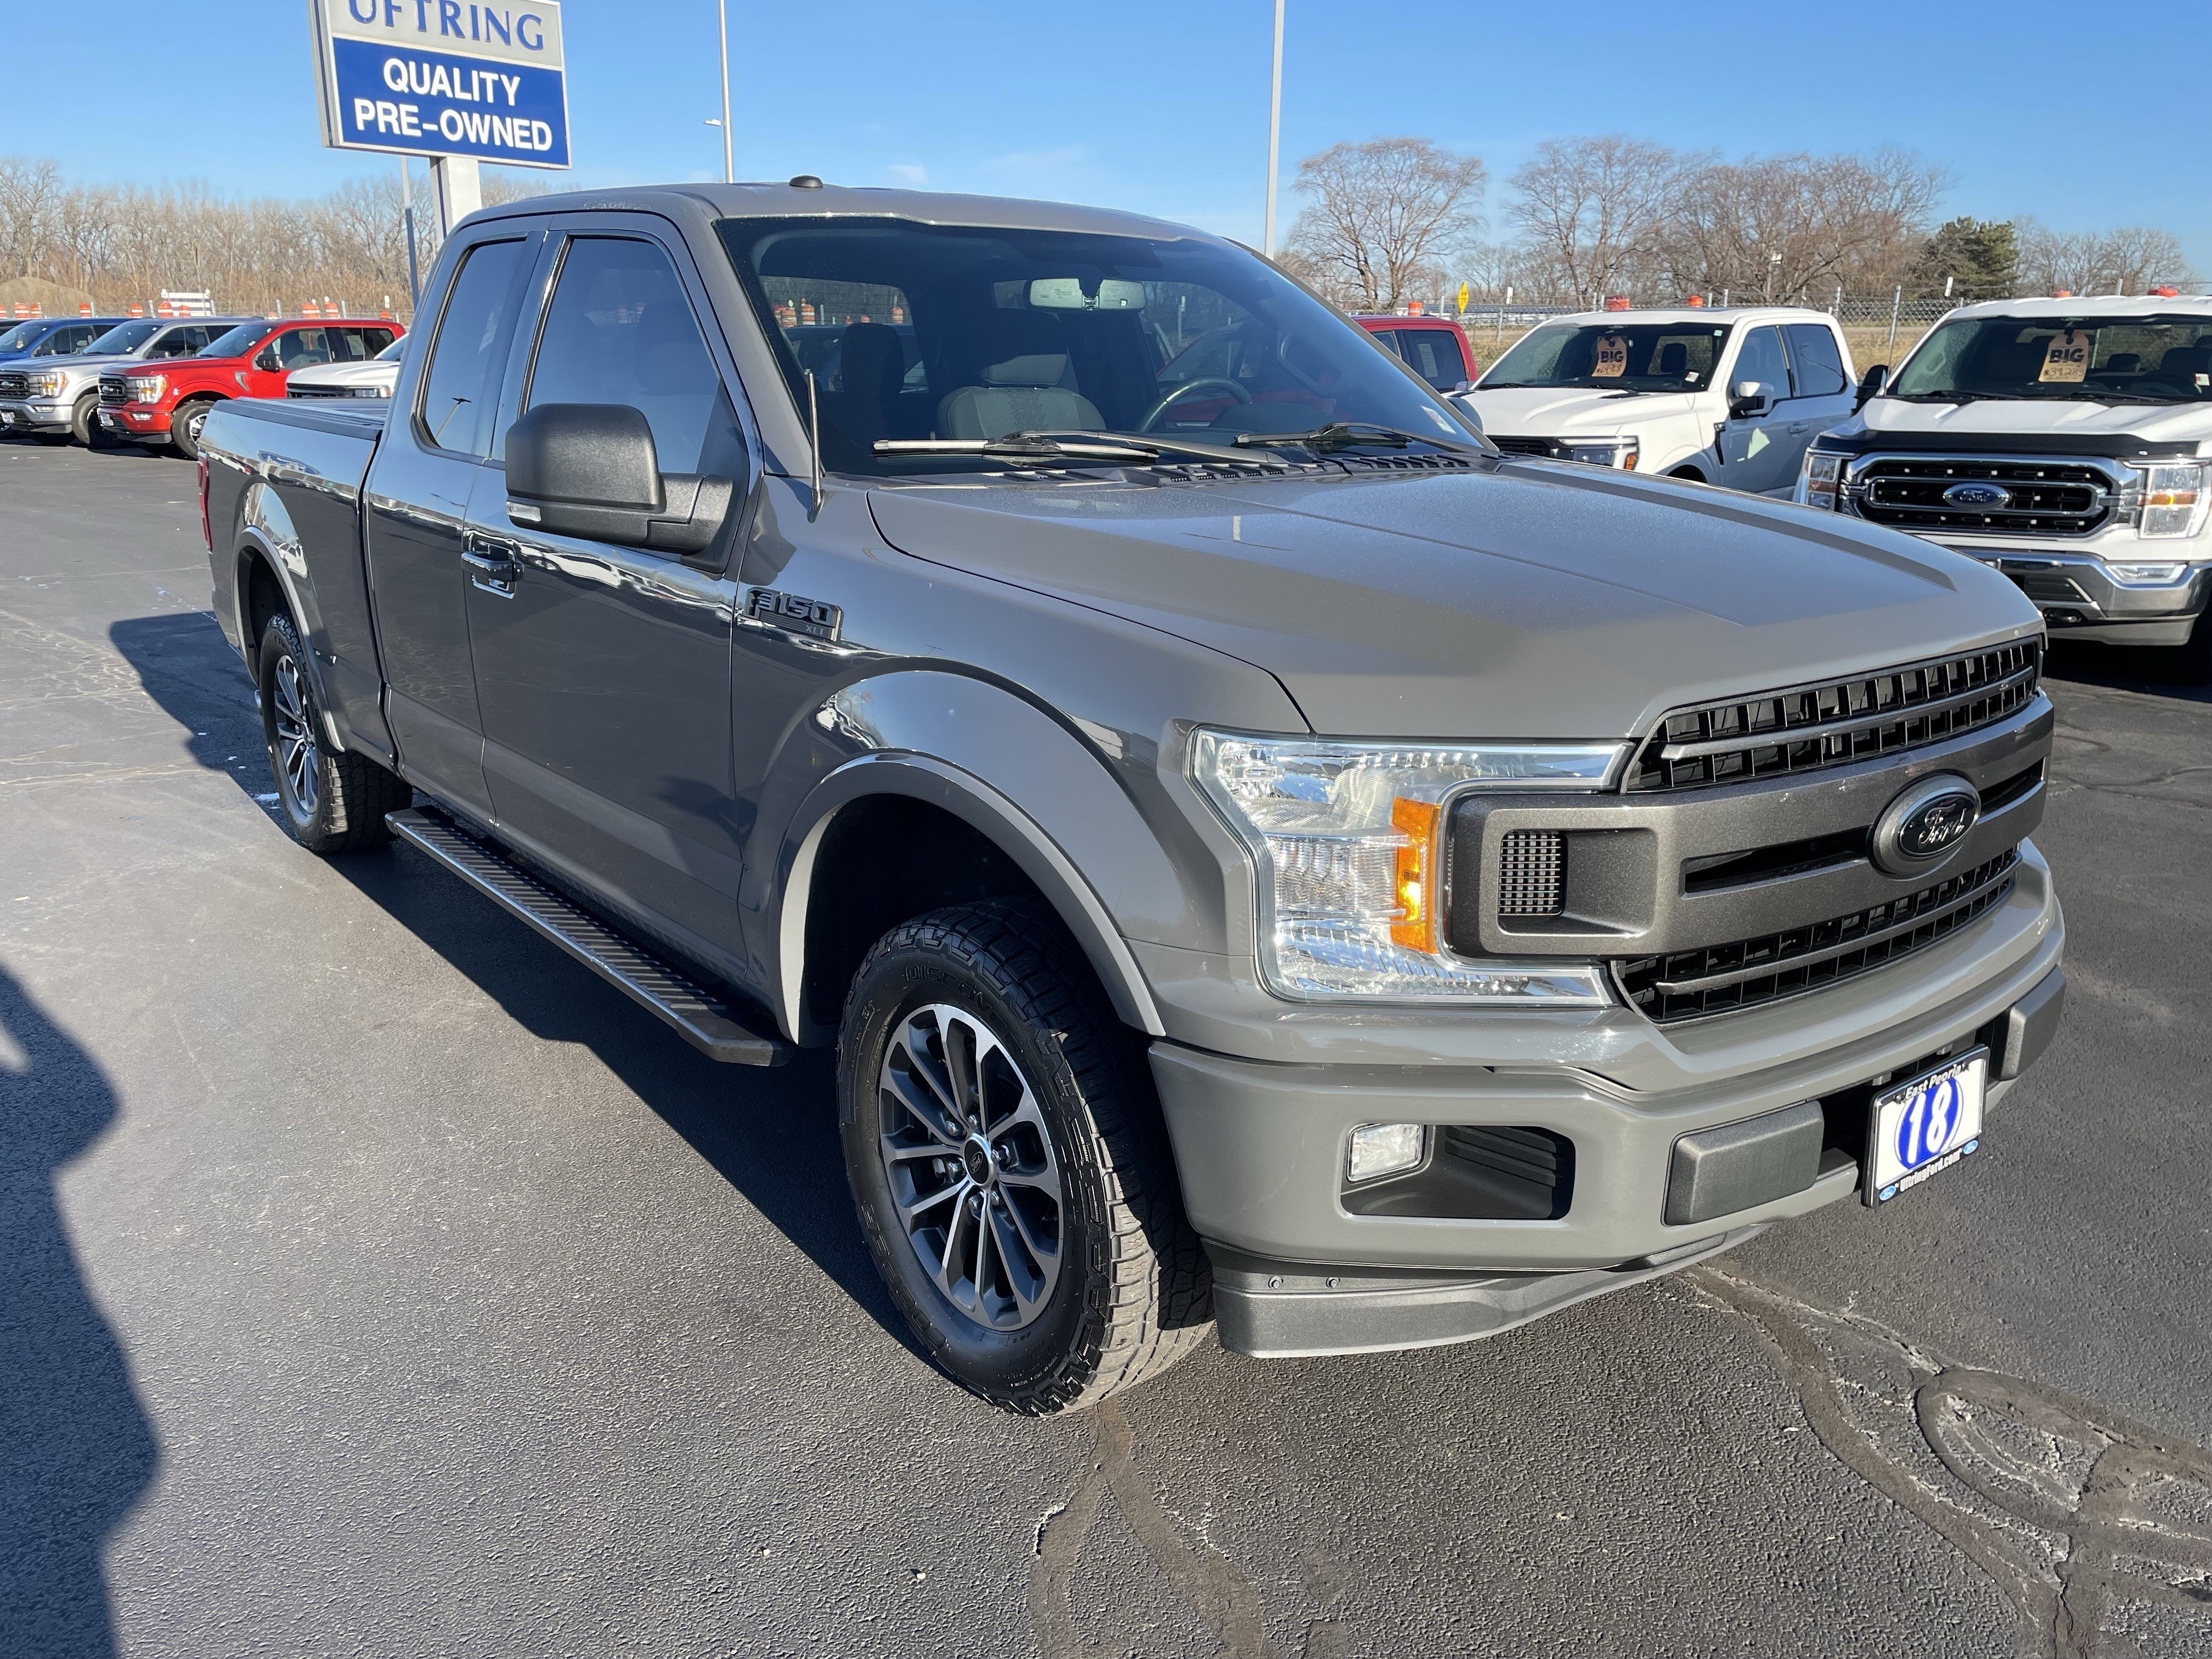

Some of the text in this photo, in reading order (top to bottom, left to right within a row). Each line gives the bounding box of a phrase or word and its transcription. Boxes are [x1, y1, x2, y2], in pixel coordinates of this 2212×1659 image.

[349, 0, 544, 51] UFTRING
[383, 58, 521, 106] QUALITY
[354, 98, 552, 151] PRE-OWNED
[1600, 350, 1624, 363] BIG
[2049, 348, 2085, 363] BIG
[805, 624, 825, 636] XLT
[1917, 800, 1968, 850] Ford
[1905, 1064, 1962, 1100] East Peoria
[1907, 1080, 1953, 1164] 18
